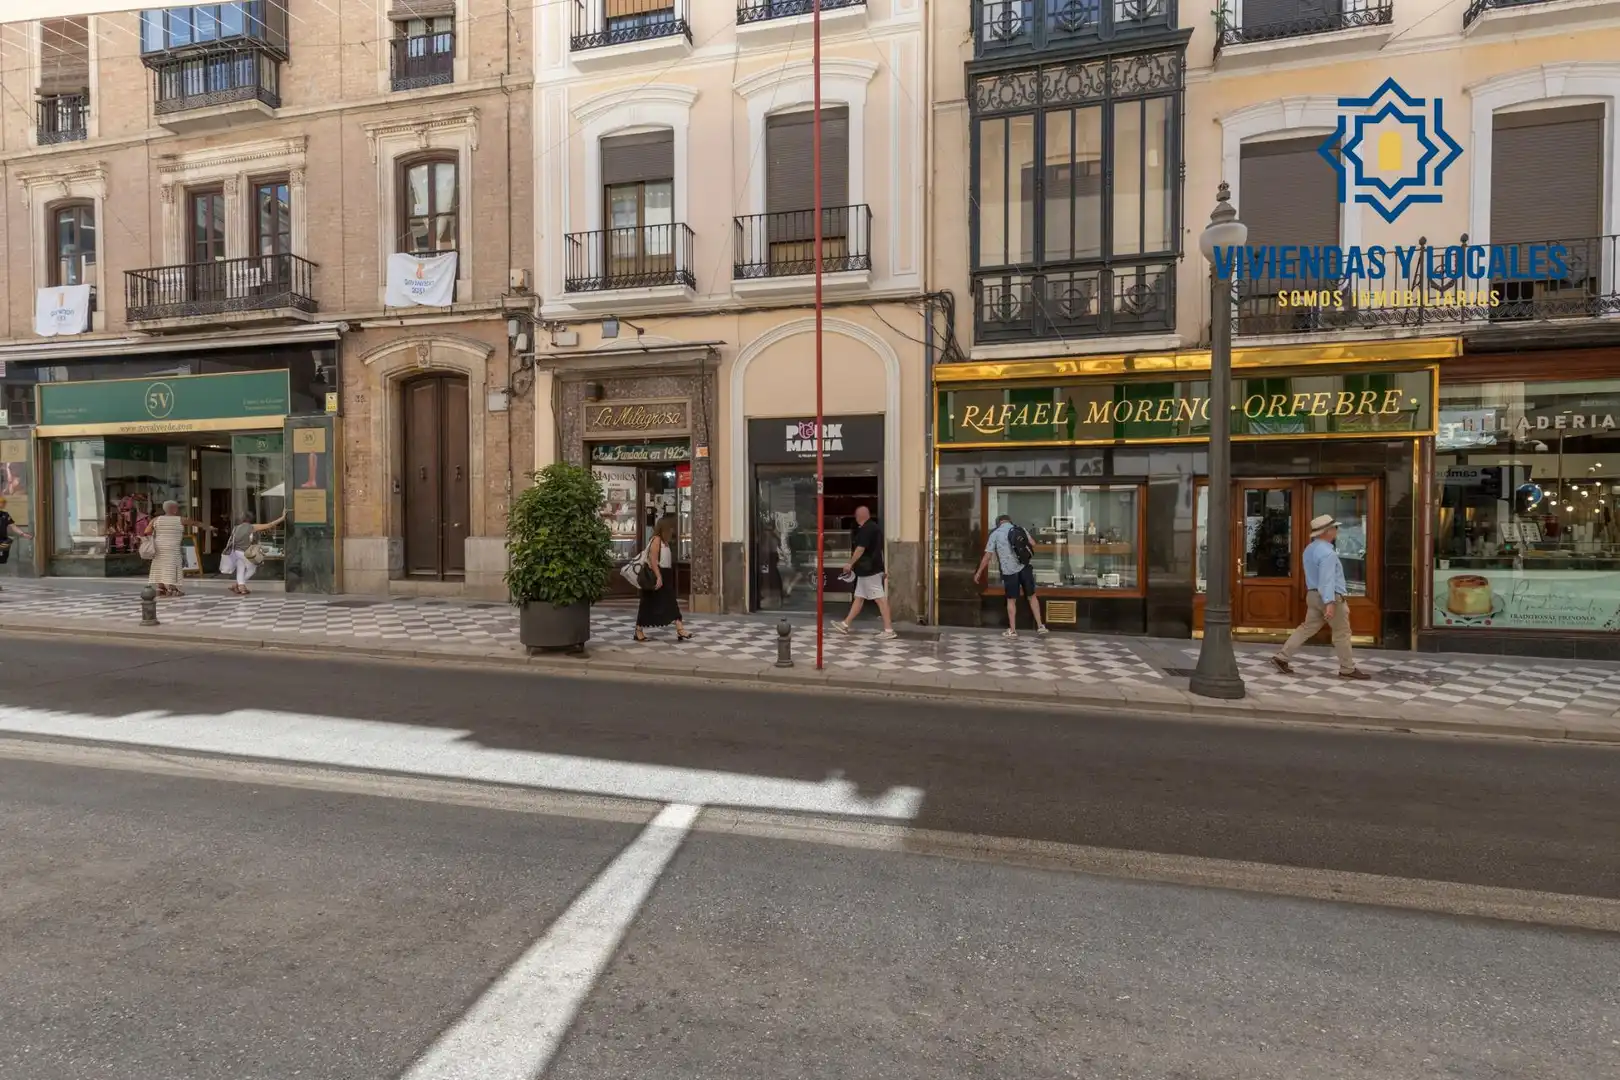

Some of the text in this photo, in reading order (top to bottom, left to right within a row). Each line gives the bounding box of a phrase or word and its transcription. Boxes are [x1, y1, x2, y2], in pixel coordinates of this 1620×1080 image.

[149, 392, 169, 409] 5V
[592, 406, 681, 429] La Milagrosa
[961, 402, 1069, 433] RAFAEL
[1243, 390, 1403, 418] ORFEBRE
[649, 451, 660, 459] en
[663, 446, 685, 460] 1925
